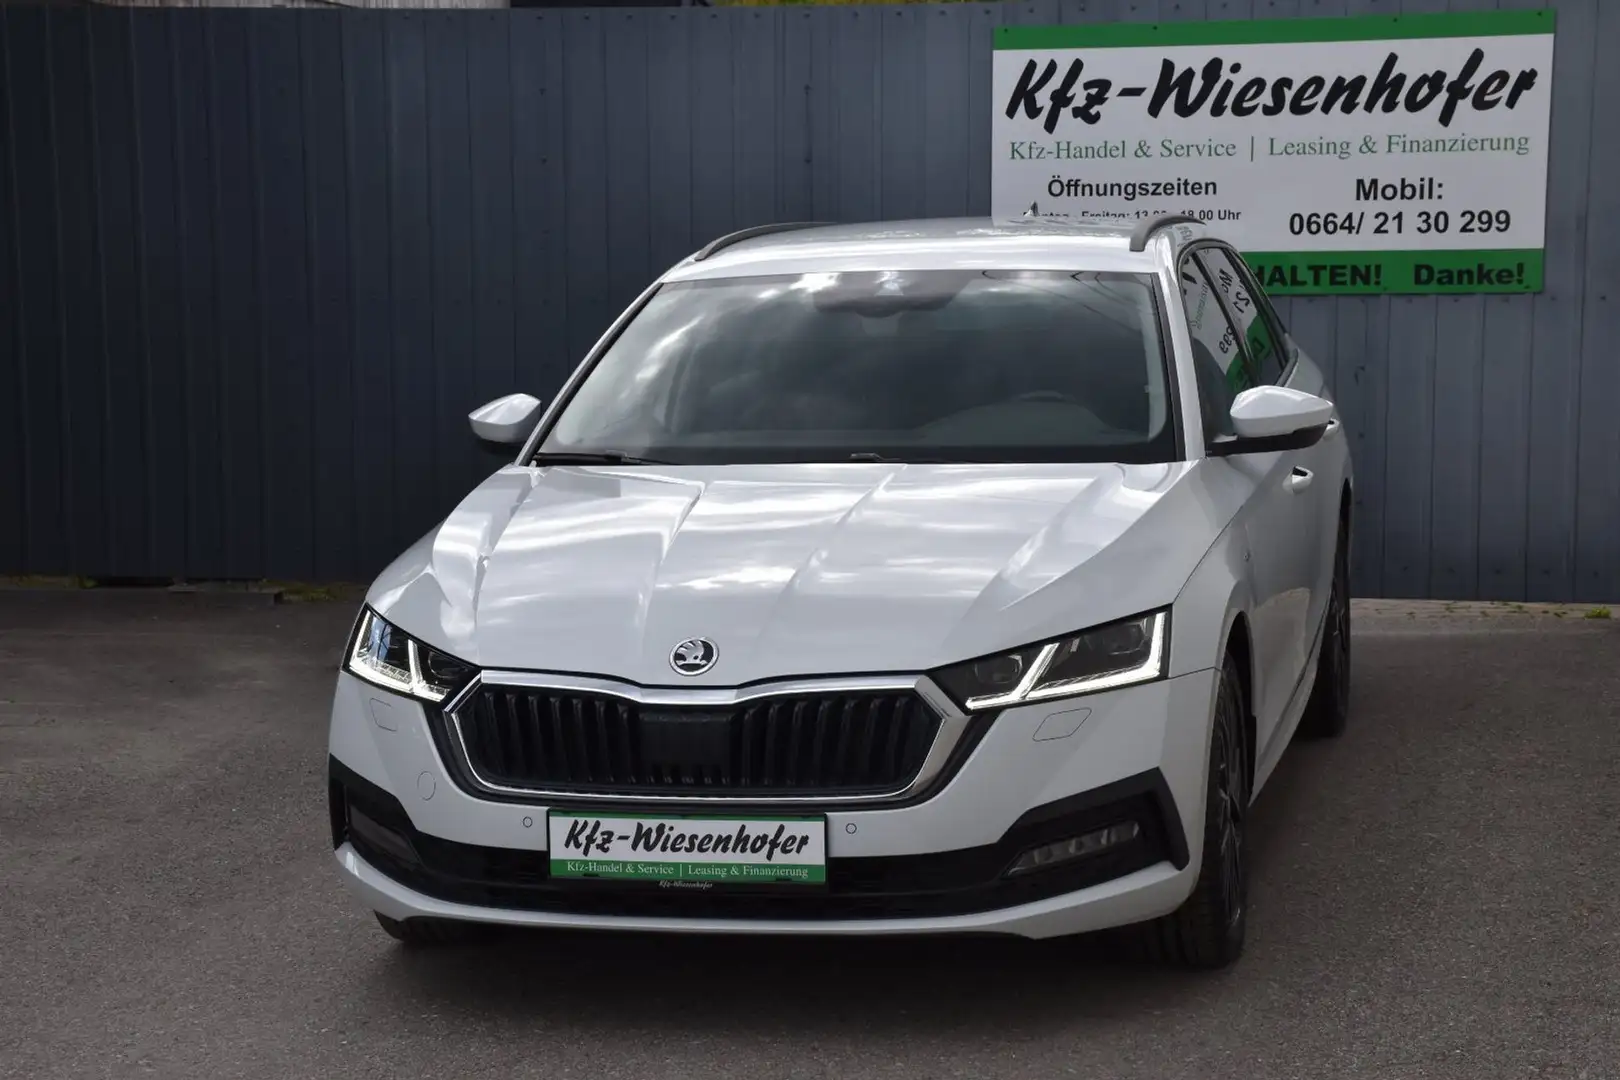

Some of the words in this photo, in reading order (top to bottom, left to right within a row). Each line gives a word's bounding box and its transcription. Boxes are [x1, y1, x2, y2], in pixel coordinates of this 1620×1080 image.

[1005, 48, 1538, 135] Kfz-Wiesenhofer
[1009, 140, 1127, 161] Kfz-Handel
[1135, 141, 1153, 158] &
[1160, 138, 1237, 157] Service
[1269, 136, 1351, 160] Leasing
[1358, 135, 1378, 155] &
[1386, 134, 1530, 156] Finanzierung
[1047, 176, 1218, 200] Öffnungszeiten
[1355, 178, 1444, 201] Mobil:
[1218, 210, 1242, 220] Uhr
[1289, 213, 1364, 236] 0664/
[1374, 212, 1404, 234] 21
[1416, 211, 1450, 233] 30
[1459, 210, 1512, 233] 299
[1414, 262, 1525, 286] Danke!
[564, 819, 809, 862] Kfz-Wiesenhofer
[567, 861, 623, 874] Kfz-Handel
[626, 863, 635, 874] &
[638, 864, 674, 875] Service
[688, 865, 728, 878] Leasing
[731, 867, 740, 877] &
[743, 866, 808, 878] Finanzierung
